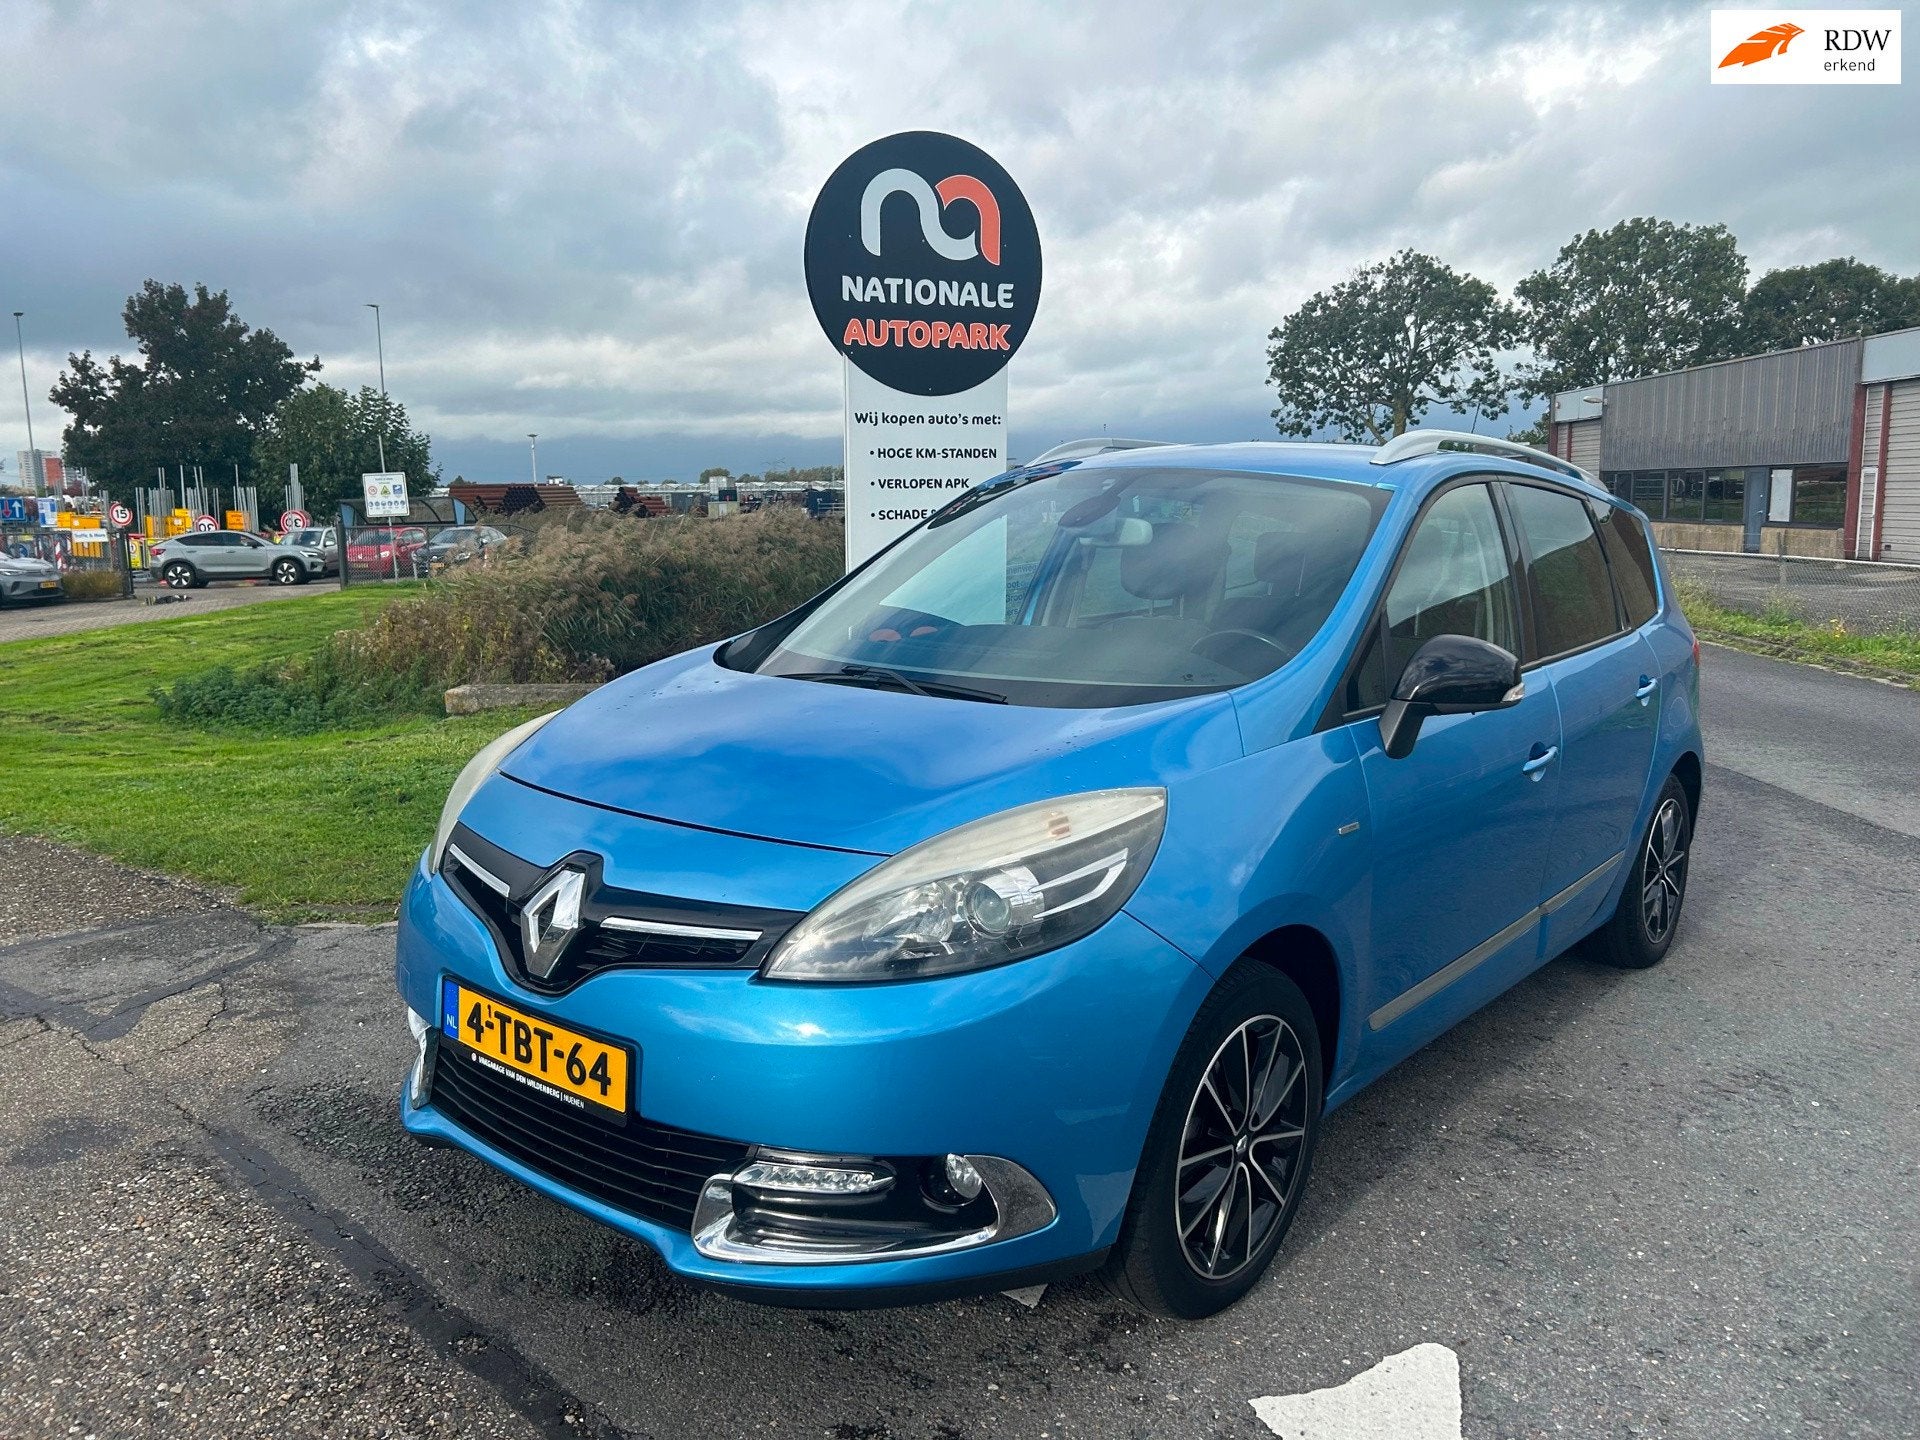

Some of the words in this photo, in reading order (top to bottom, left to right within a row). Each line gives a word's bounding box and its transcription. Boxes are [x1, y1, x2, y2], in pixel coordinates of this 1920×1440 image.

[841, 275, 1014, 309] NATIONALE
[843, 318, 1011, 351] AUTOPARK
[854, 412, 878, 427] Wij
[881, 412, 925, 427] kopen
[928, 413, 969, 425] auto's
[971, 414, 1002, 425] met:
[877, 448, 913, 459] HOGE
[916, 448, 997, 459] KM-STANDEN
[878, 478, 943, 489] VERLOPEN
[945, 478, 970, 489] APK
[115, 509, 128, 519] 15
[878, 509, 928, 520] SCHADE
[446, 1013, 458, 1029] NL
[466, 1002, 612, 1096] 4-TBT-64
